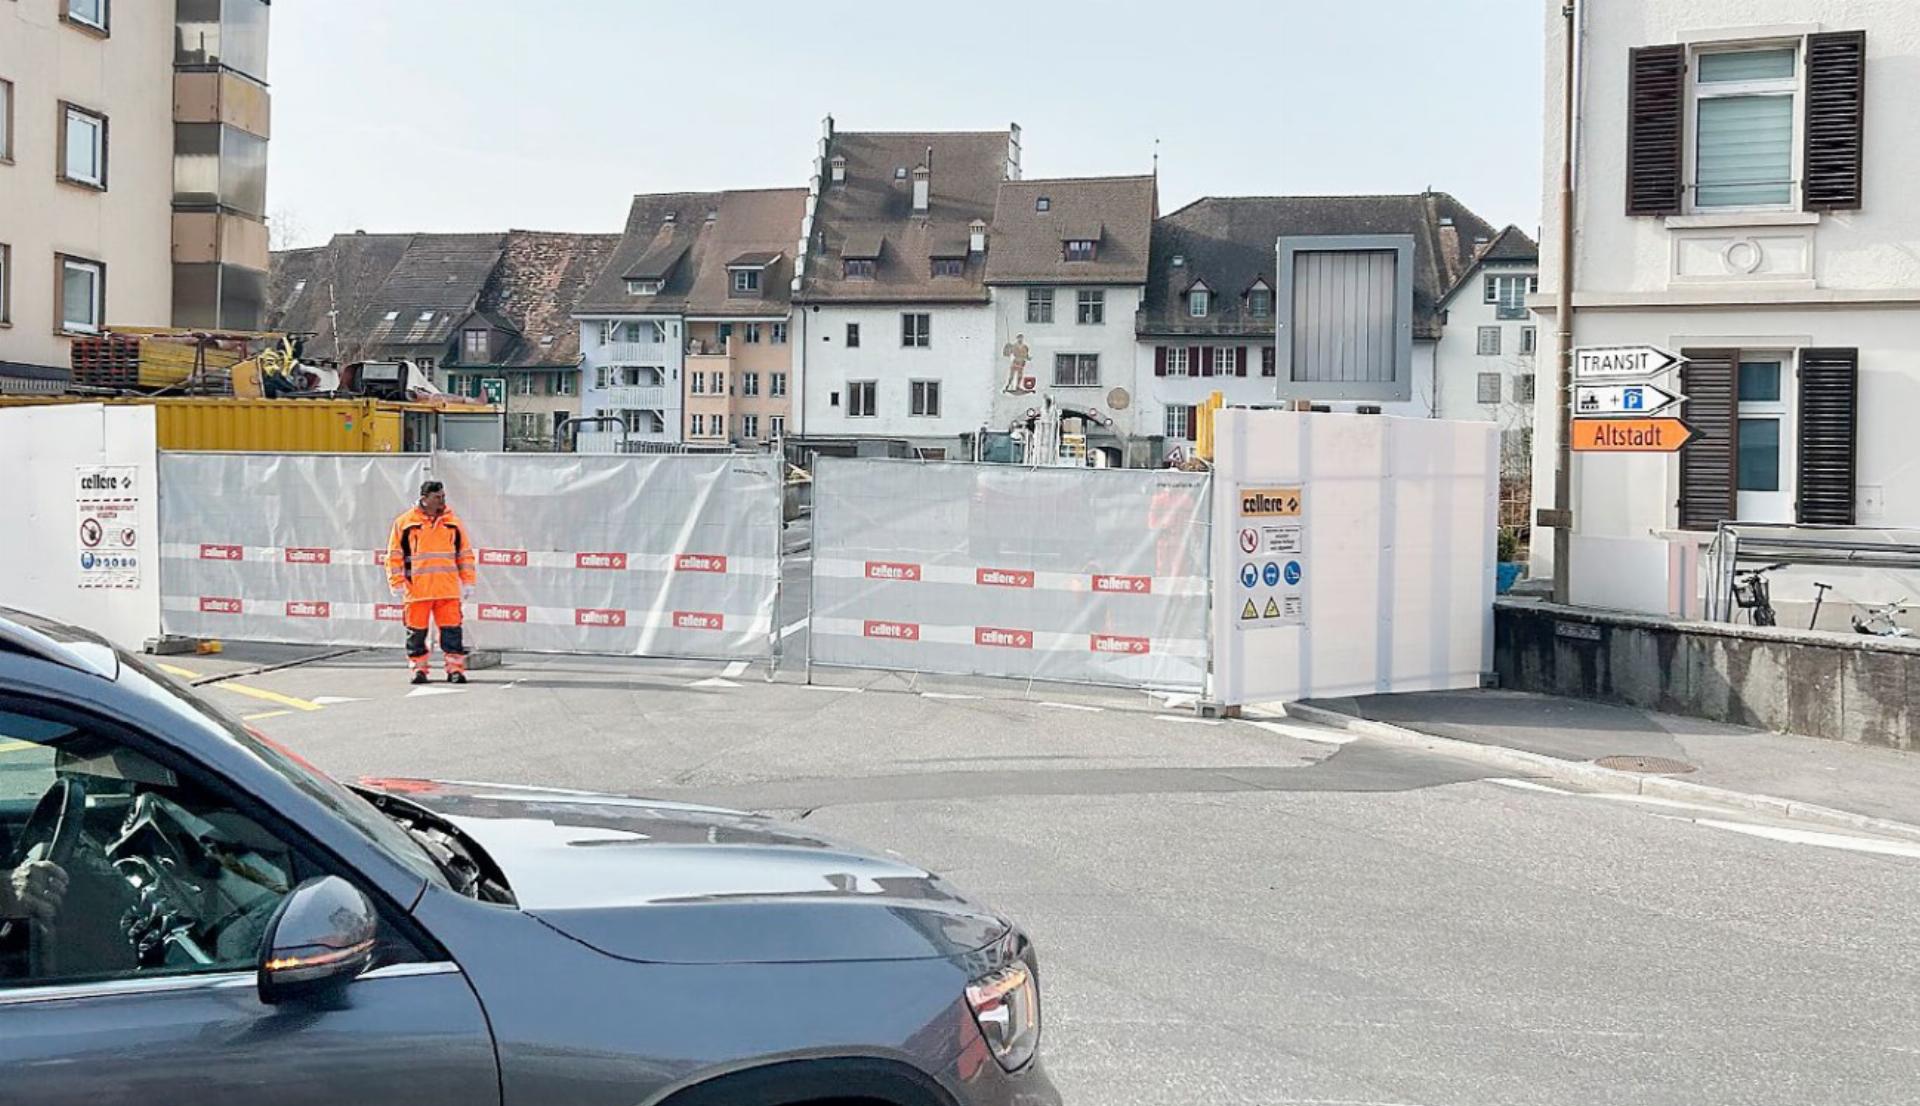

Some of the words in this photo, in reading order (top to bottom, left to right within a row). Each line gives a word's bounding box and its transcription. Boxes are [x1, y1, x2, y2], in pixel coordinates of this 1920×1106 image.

[1582, 353, 1648, 371] TRANSIT
[1594, 424, 1662, 446] Altstadt
[81, 474, 118, 489] cellere
[1243, 494, 1283, 513] cellere
[871, 564, 903, 577] cellere
[983, 572, 1015, 585] cellere
[678, 615, 708, 627] cellere
[870, 624, 901, 637] cellere
[982, 631, 1014, 645] cellere
